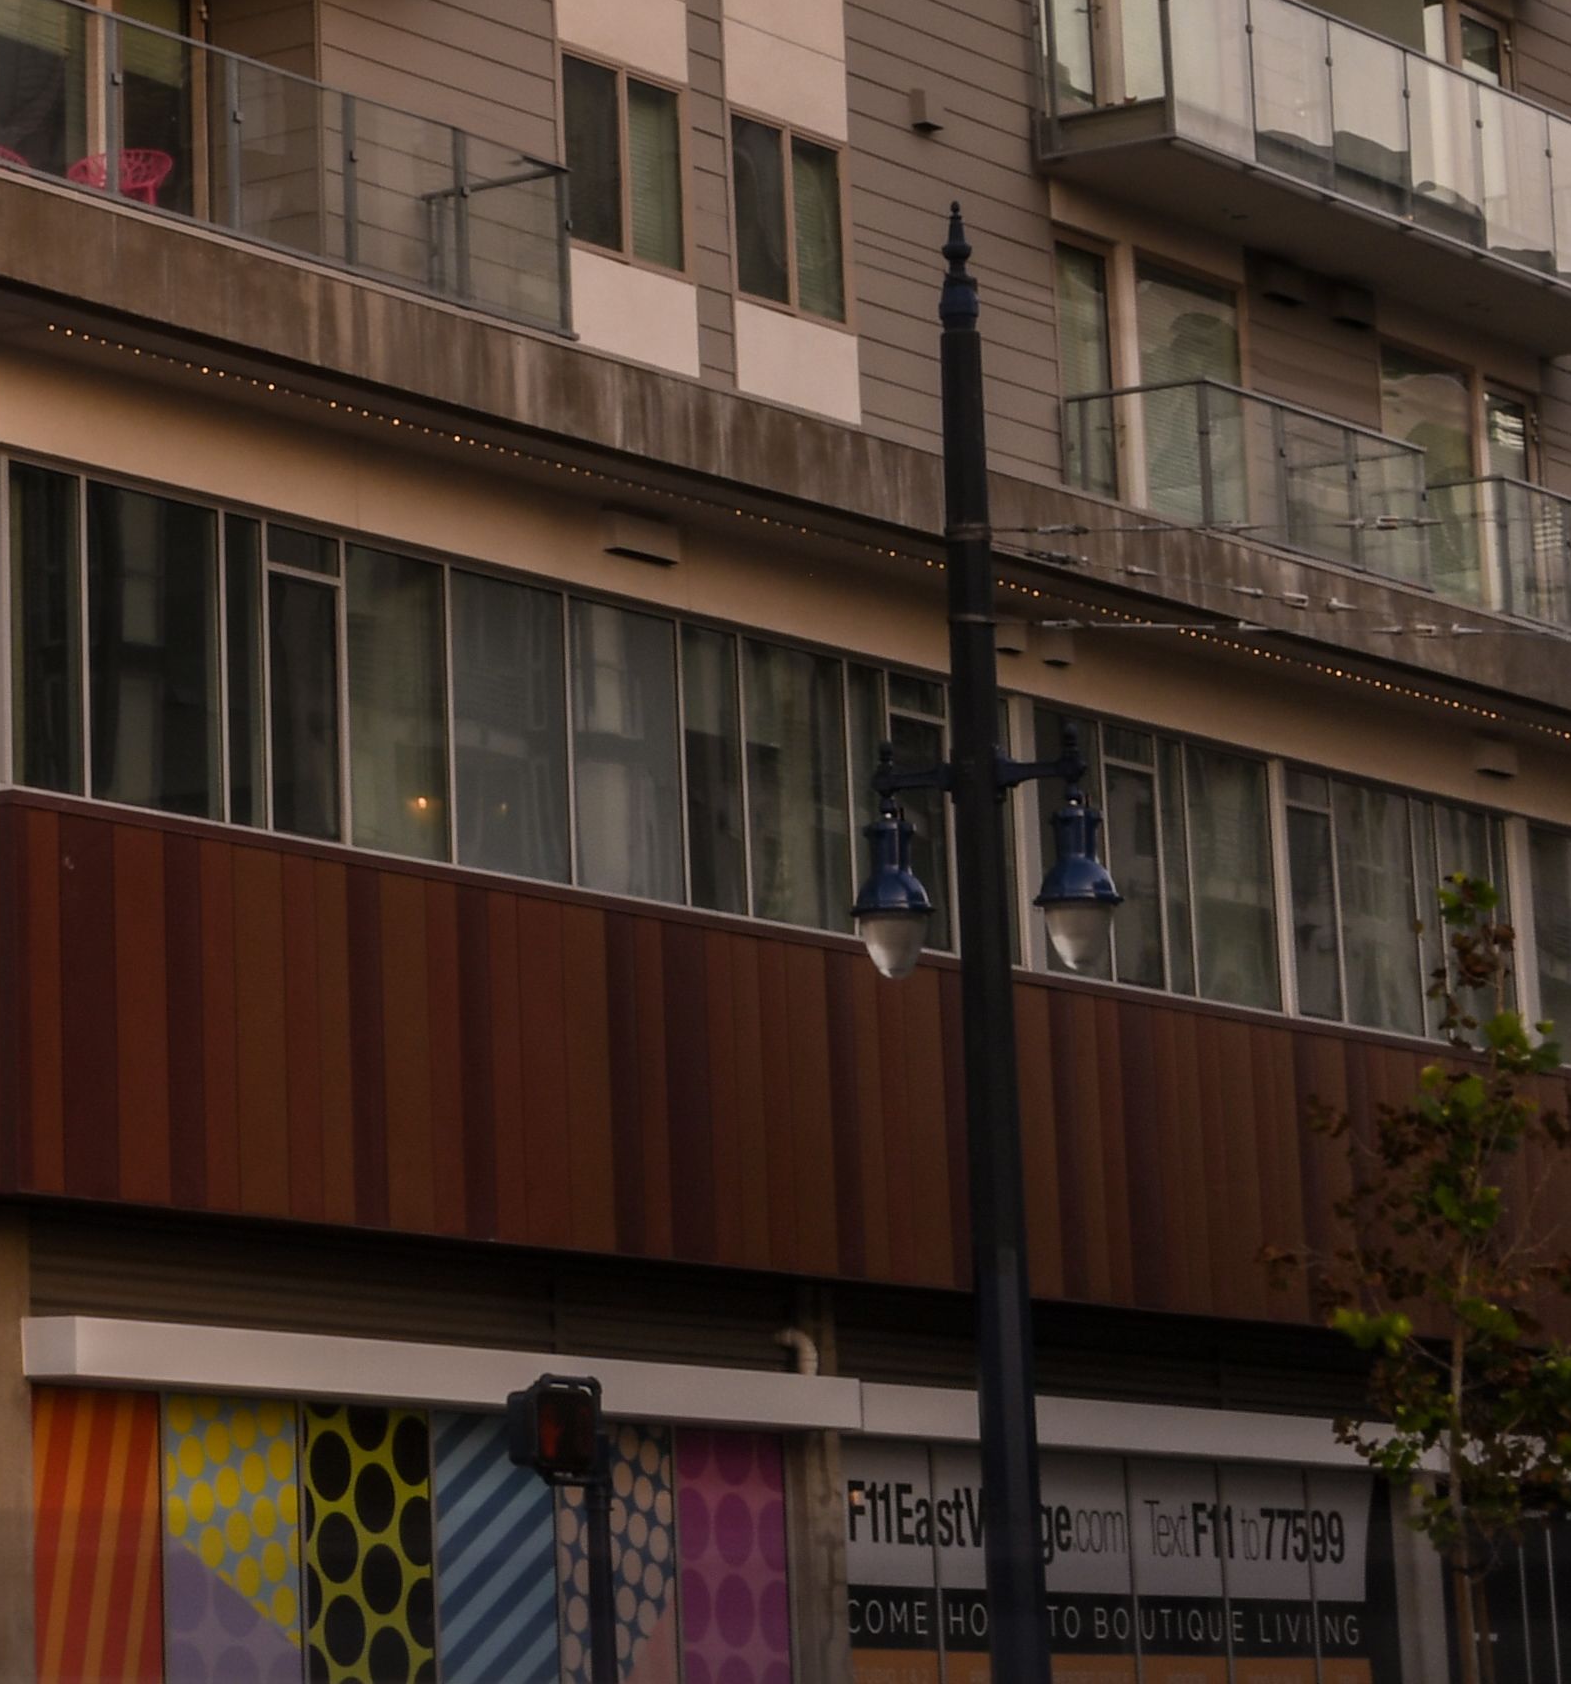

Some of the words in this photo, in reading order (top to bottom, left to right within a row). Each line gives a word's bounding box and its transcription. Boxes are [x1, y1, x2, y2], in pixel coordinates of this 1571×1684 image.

[848, 1480, 1131, 1566] F11EastVge.com
[1144, 1499, 1190, 1558] Text
[1192, 1502, 1234, 1560] F11
[1241, 1516, 1259, 1562] to
[1260, 1507, 1346, 1565] 77599
[847, 1598, 928, 1636] COME
[1047, 1605, 1082, 1638] TO
[1094, 1607, 1245, 1643] BOUTIQUE
[1259, 1612, 1359, 1646] LIVING
